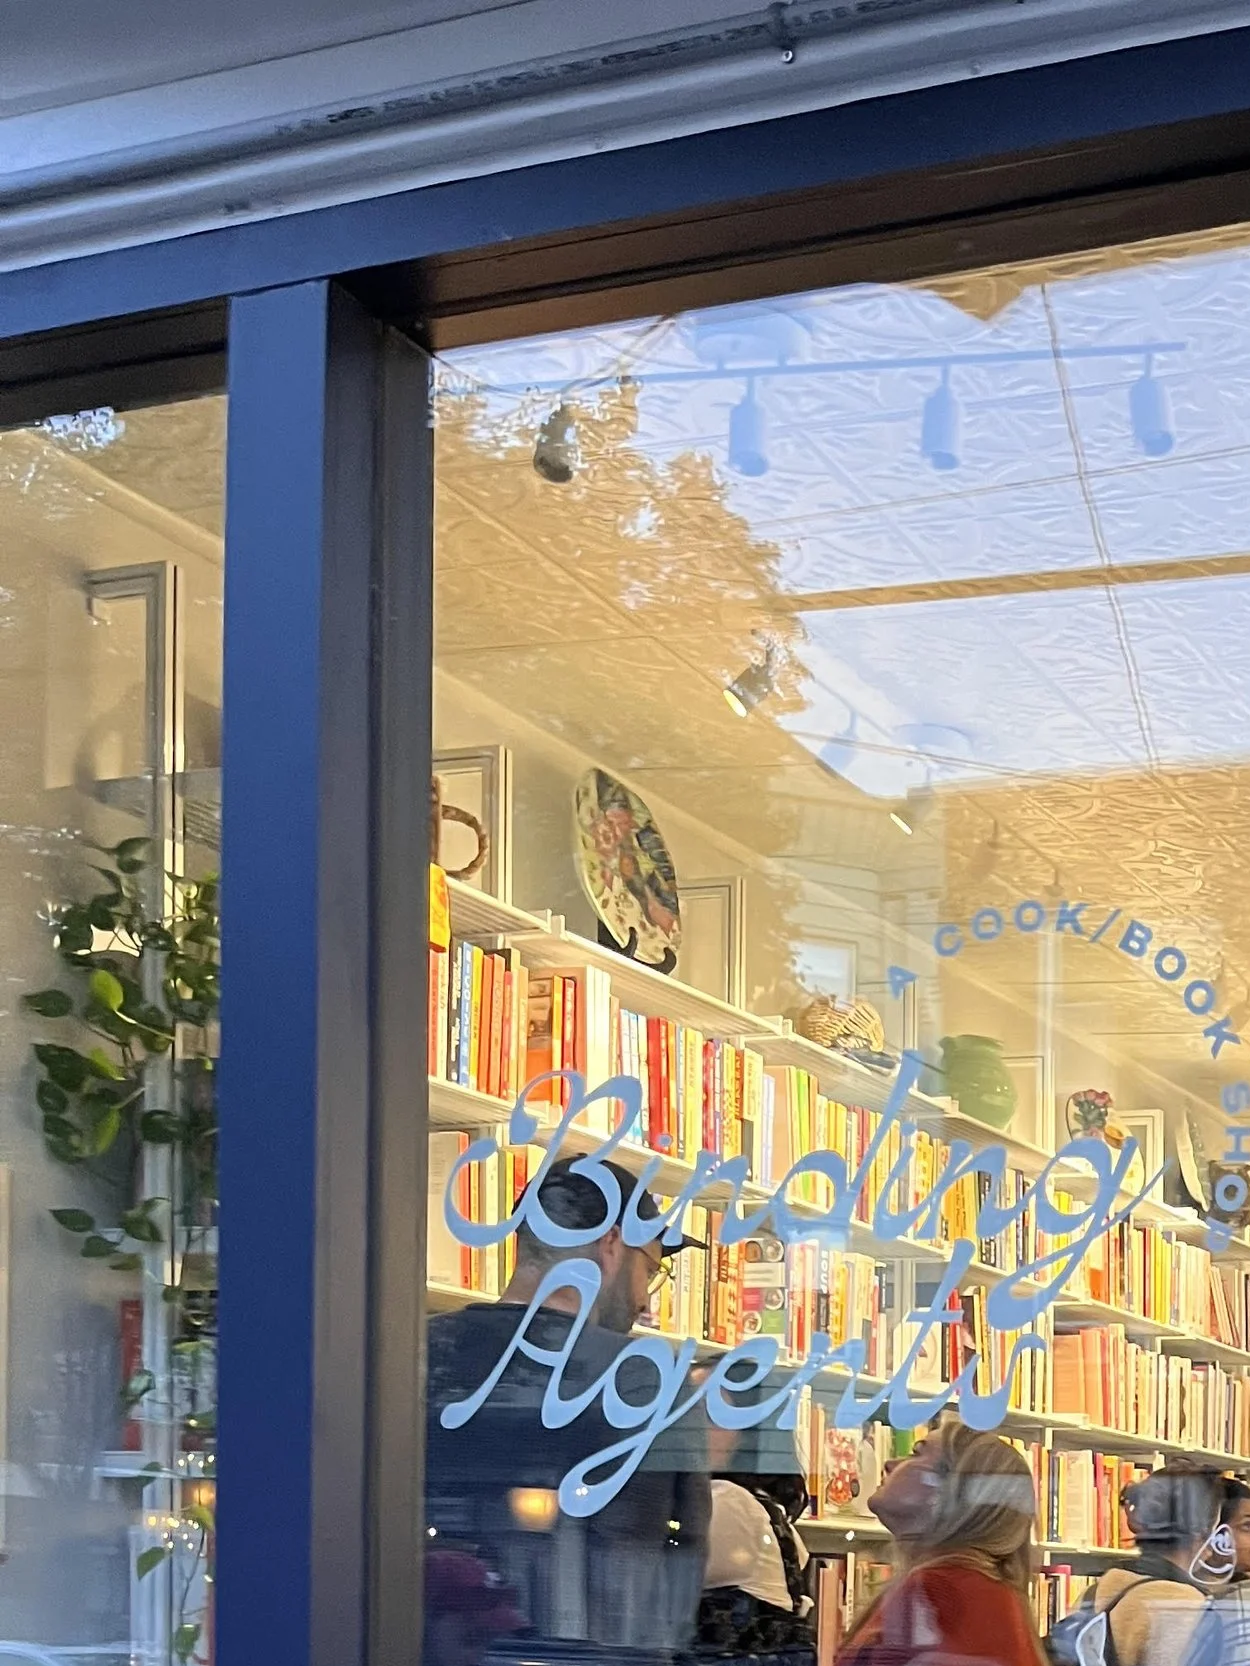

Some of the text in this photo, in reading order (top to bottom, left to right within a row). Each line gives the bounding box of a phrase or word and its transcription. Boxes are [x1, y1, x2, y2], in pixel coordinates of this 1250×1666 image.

[886, 965, 918, 999] A
[933, 900, 1243, 1060] COOK/BOOK
[444, 1050, 1173, 1331] Binding
[440, 1239, 1048, 1517] Agents
